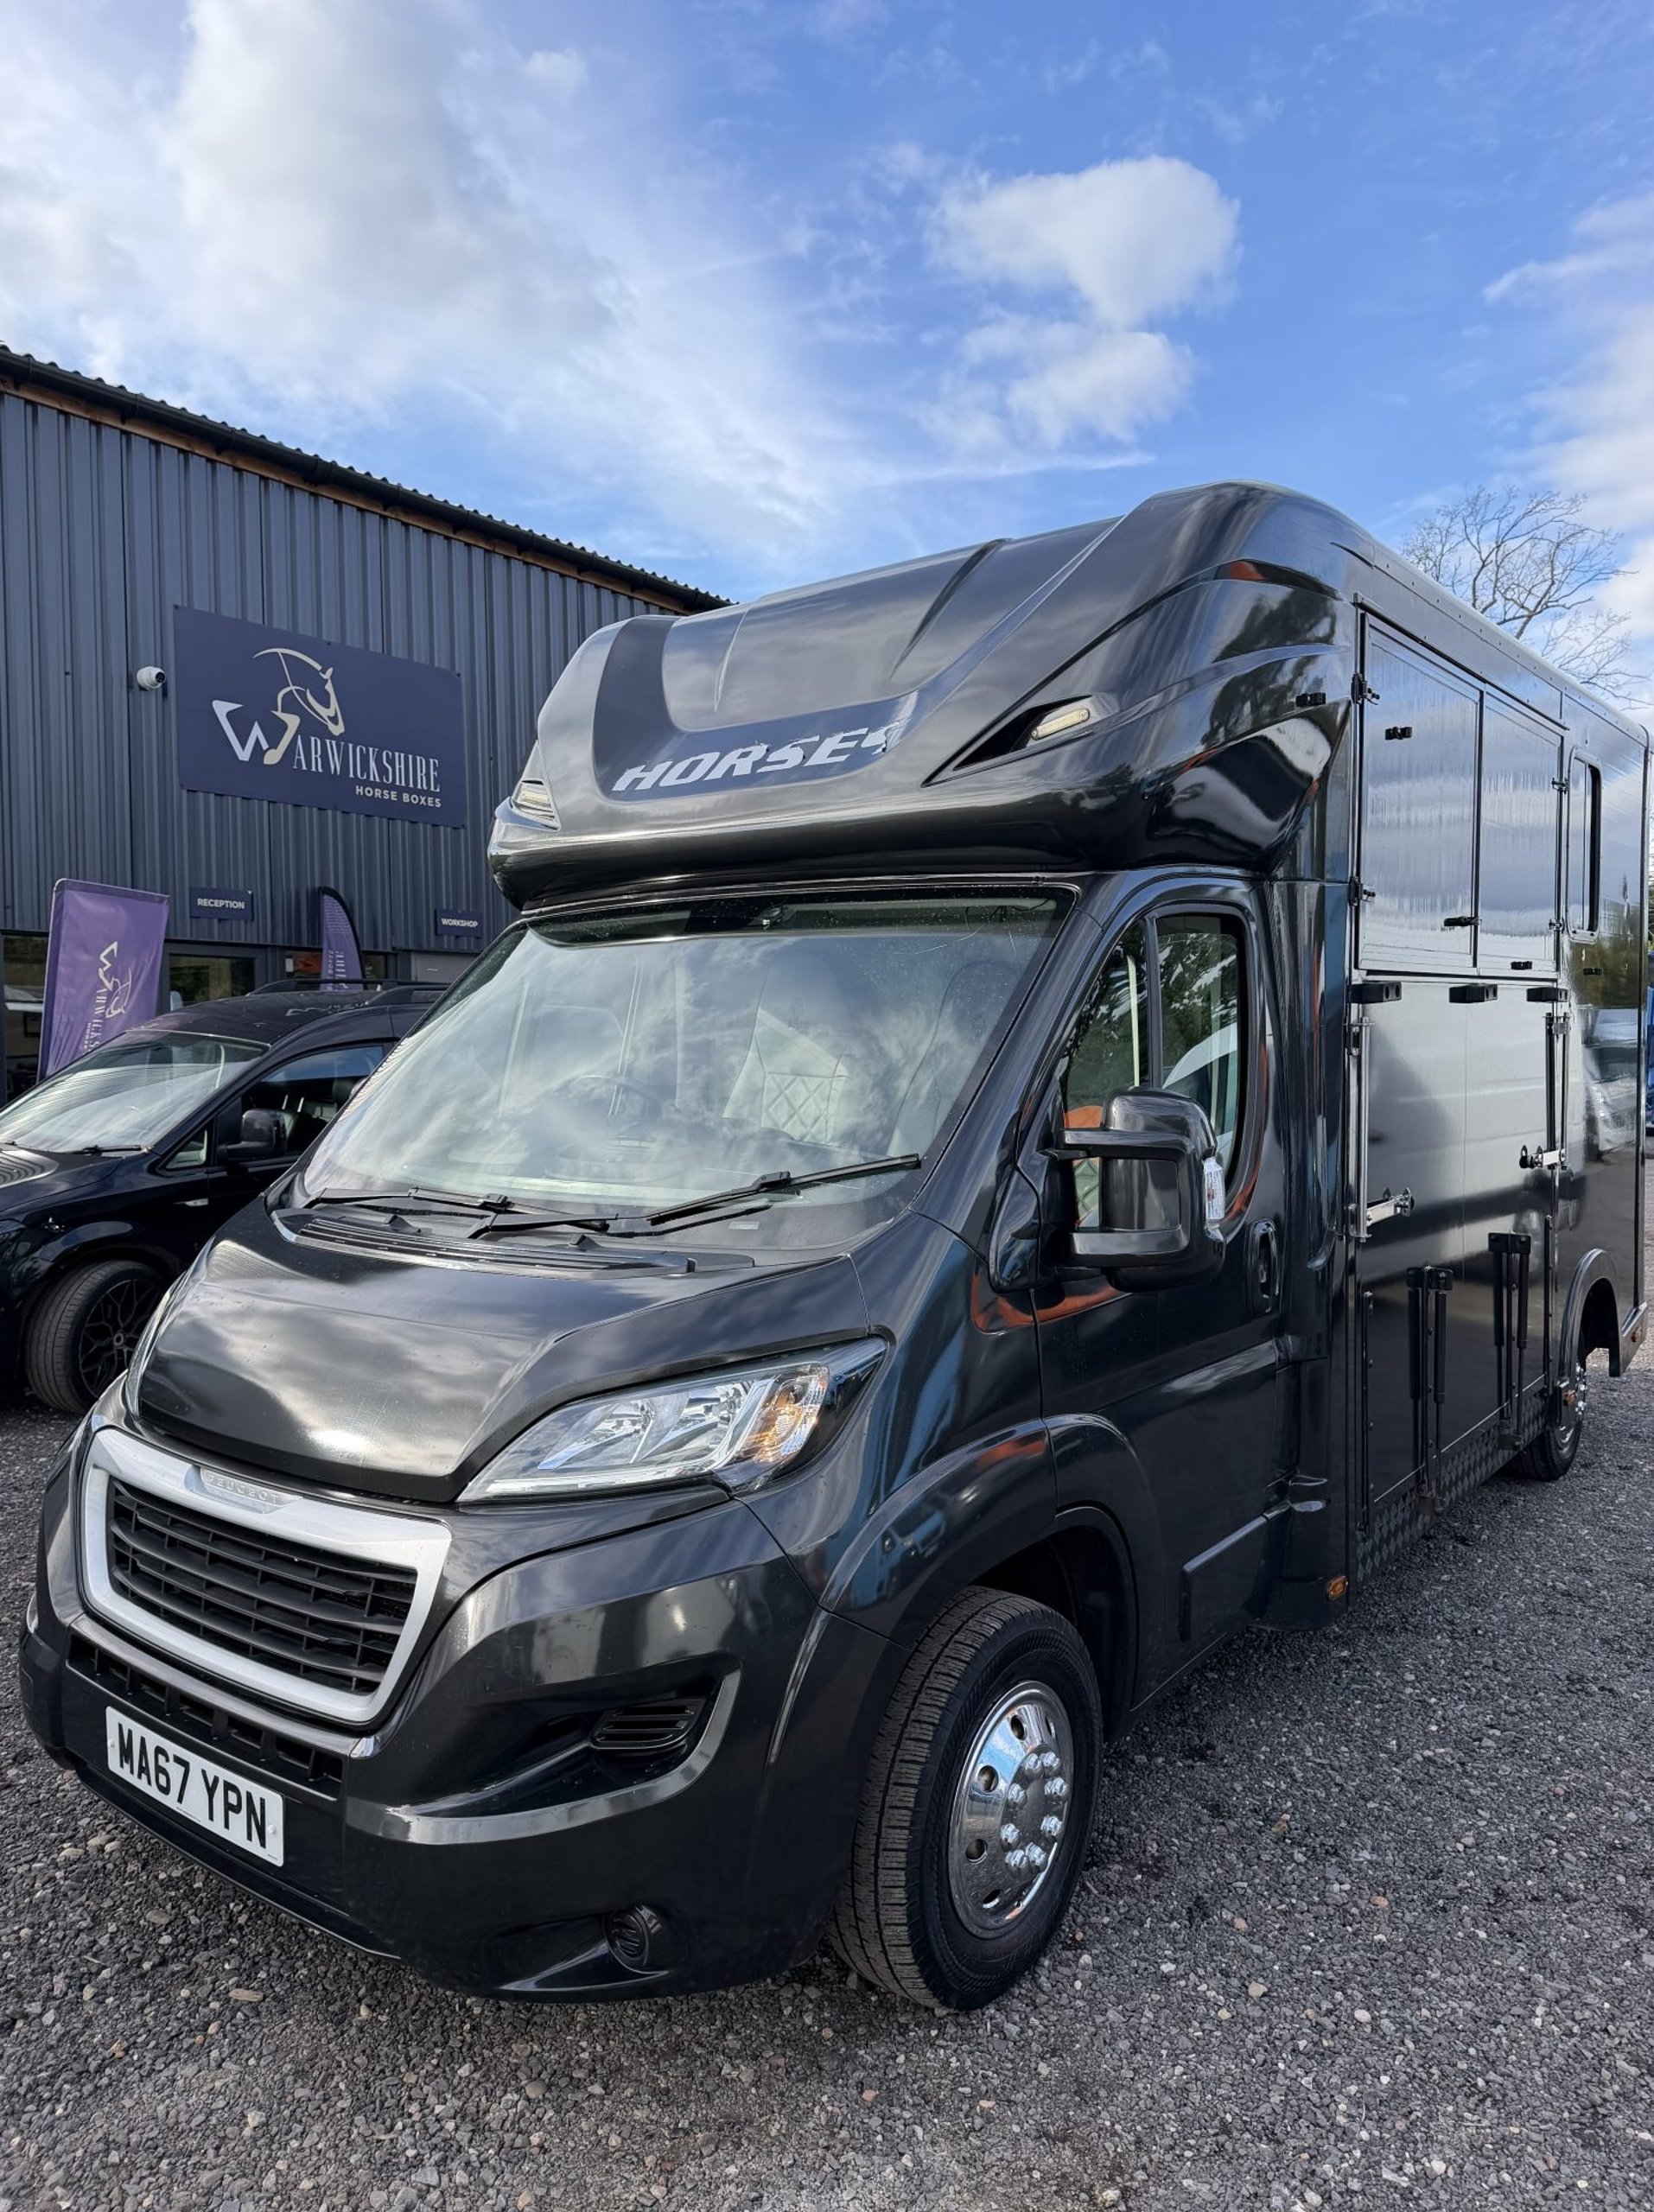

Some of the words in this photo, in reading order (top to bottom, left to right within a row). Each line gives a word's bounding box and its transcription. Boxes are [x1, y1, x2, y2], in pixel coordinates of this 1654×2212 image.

[212, 700, 441, 792] WARWICKSHIRE
[355, 785, 398, 801] HORSE
[403, 792, 442, 808] BOXES
[197, 898, 245, 910] RECEPTION
[441, 918, 478, 928] WORKSHOP
[207, 1474, 278, 1503] PEUGEOT
[118, 1722, 190, 1805] MA67
[200, 1768, 267, 1850] YPN
